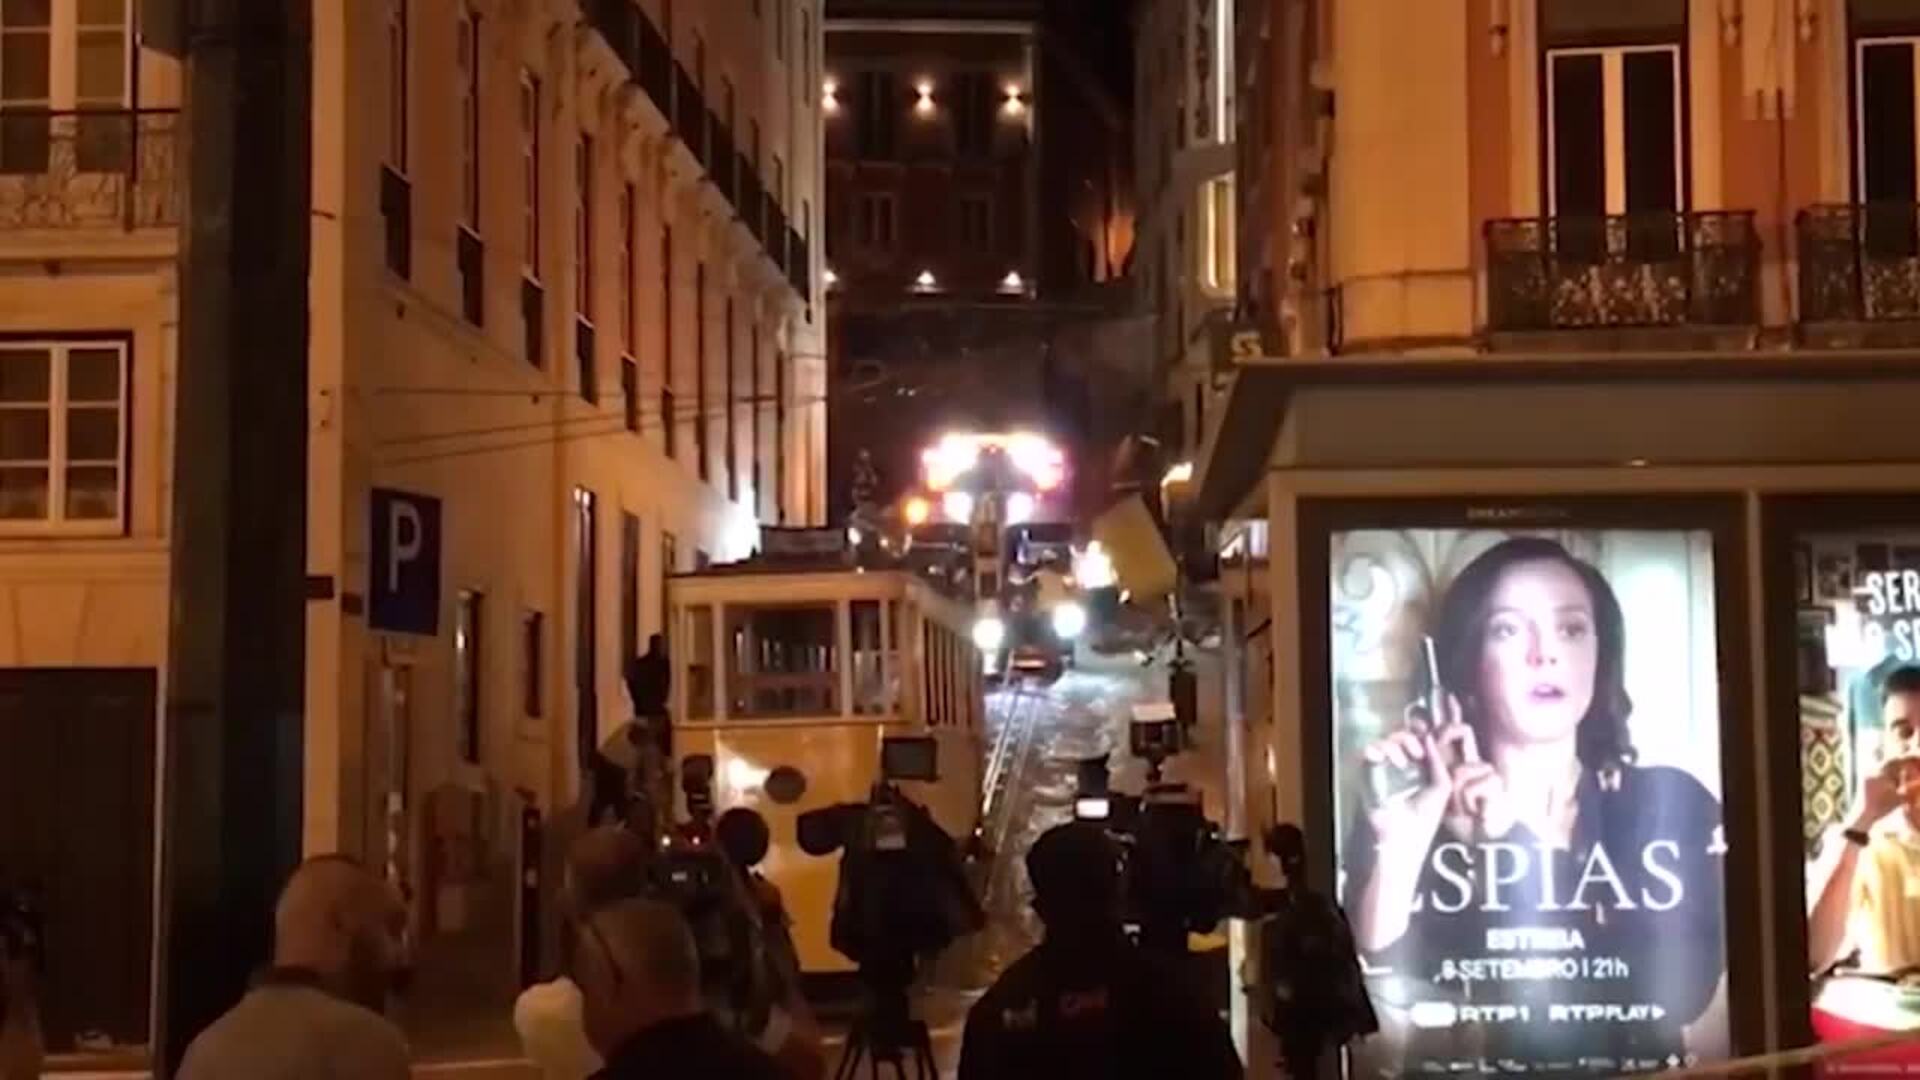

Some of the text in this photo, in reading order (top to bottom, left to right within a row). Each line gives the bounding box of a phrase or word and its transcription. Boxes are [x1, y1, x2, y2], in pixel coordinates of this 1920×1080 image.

[388, 498, 422, 593] P
[1591, 956, 1630, 979] 21h
[1459, 1004, 1531, 1023] RTP1
